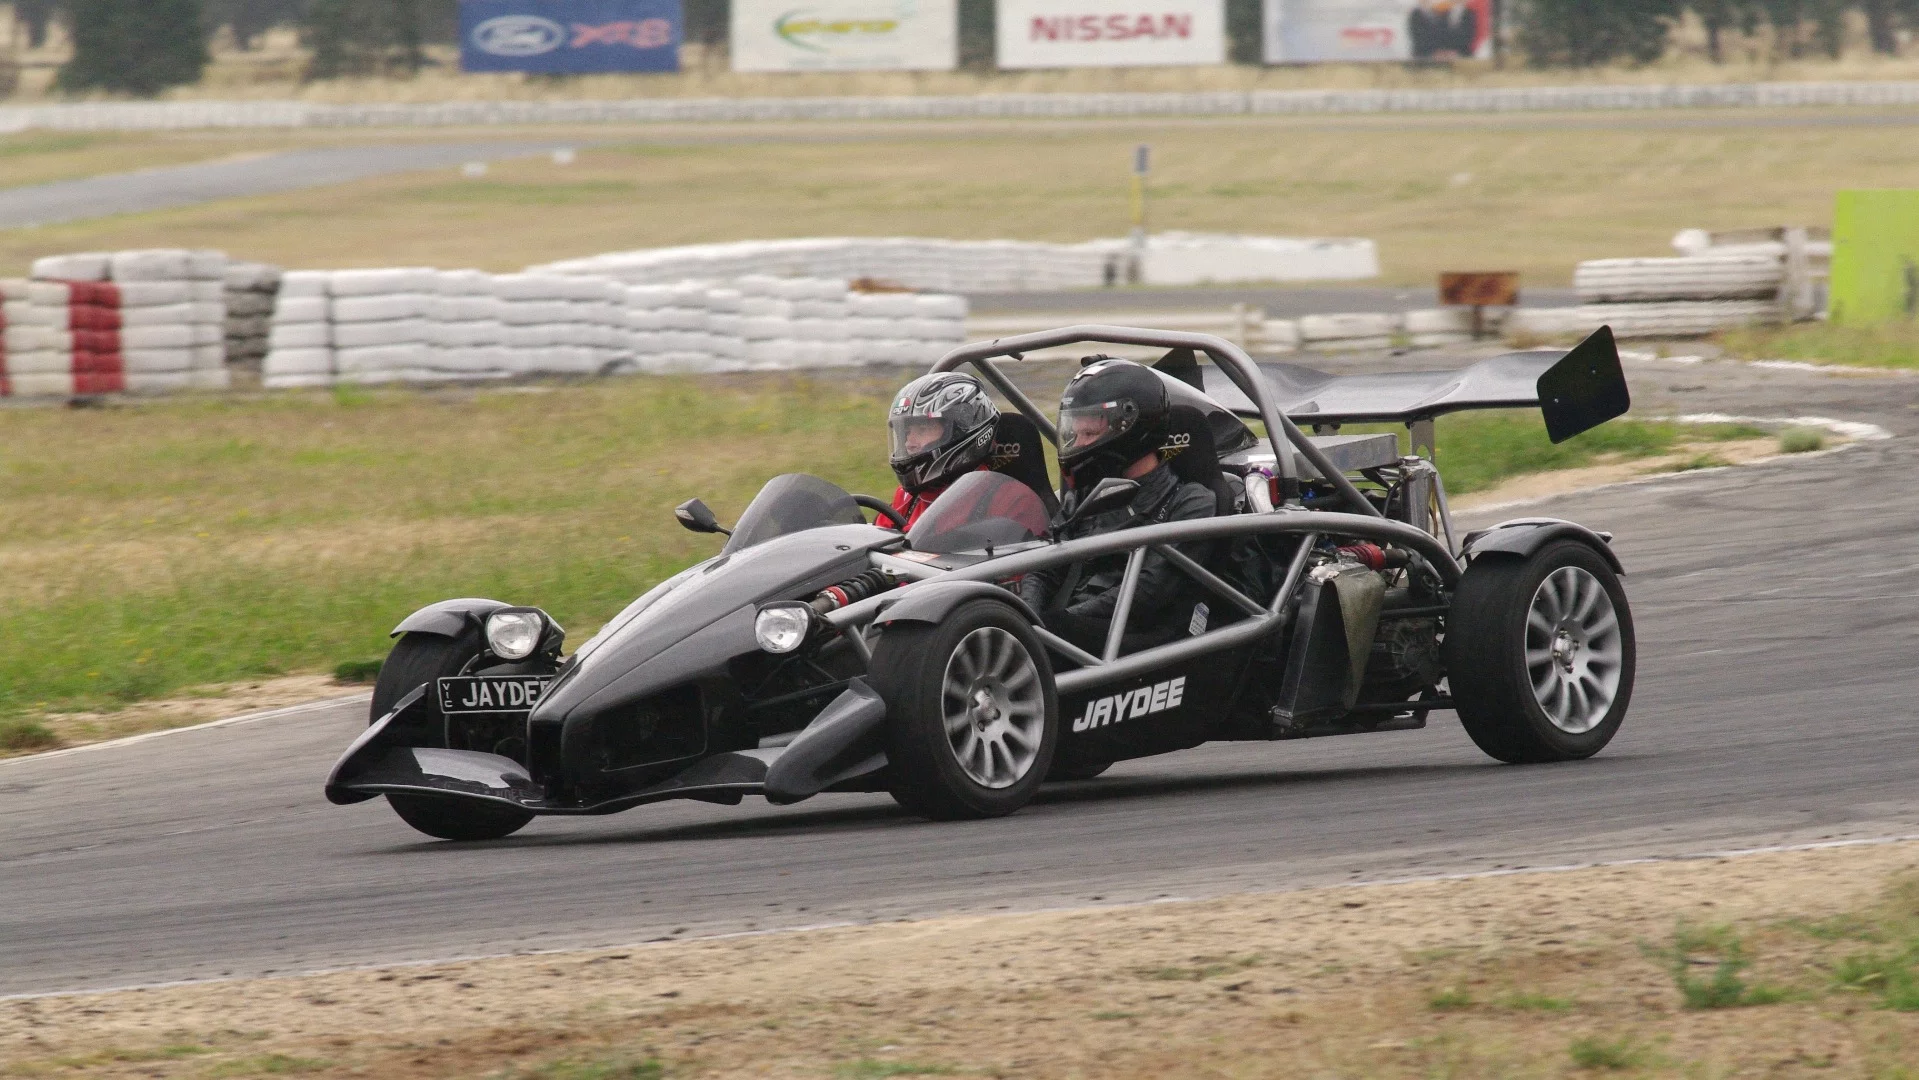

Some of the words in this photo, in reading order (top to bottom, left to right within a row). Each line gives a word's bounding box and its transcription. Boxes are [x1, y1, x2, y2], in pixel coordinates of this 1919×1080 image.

[1029, 13, 1193, 43] NISSAN
[977, 426, 994, 448] agv
[995, 442, 1021, 454] rco
[1165, 433, 1190, 446] rco
[442, 683, 453, 708] VIC
[1072, 676, 1187, 732] JAYDEE
